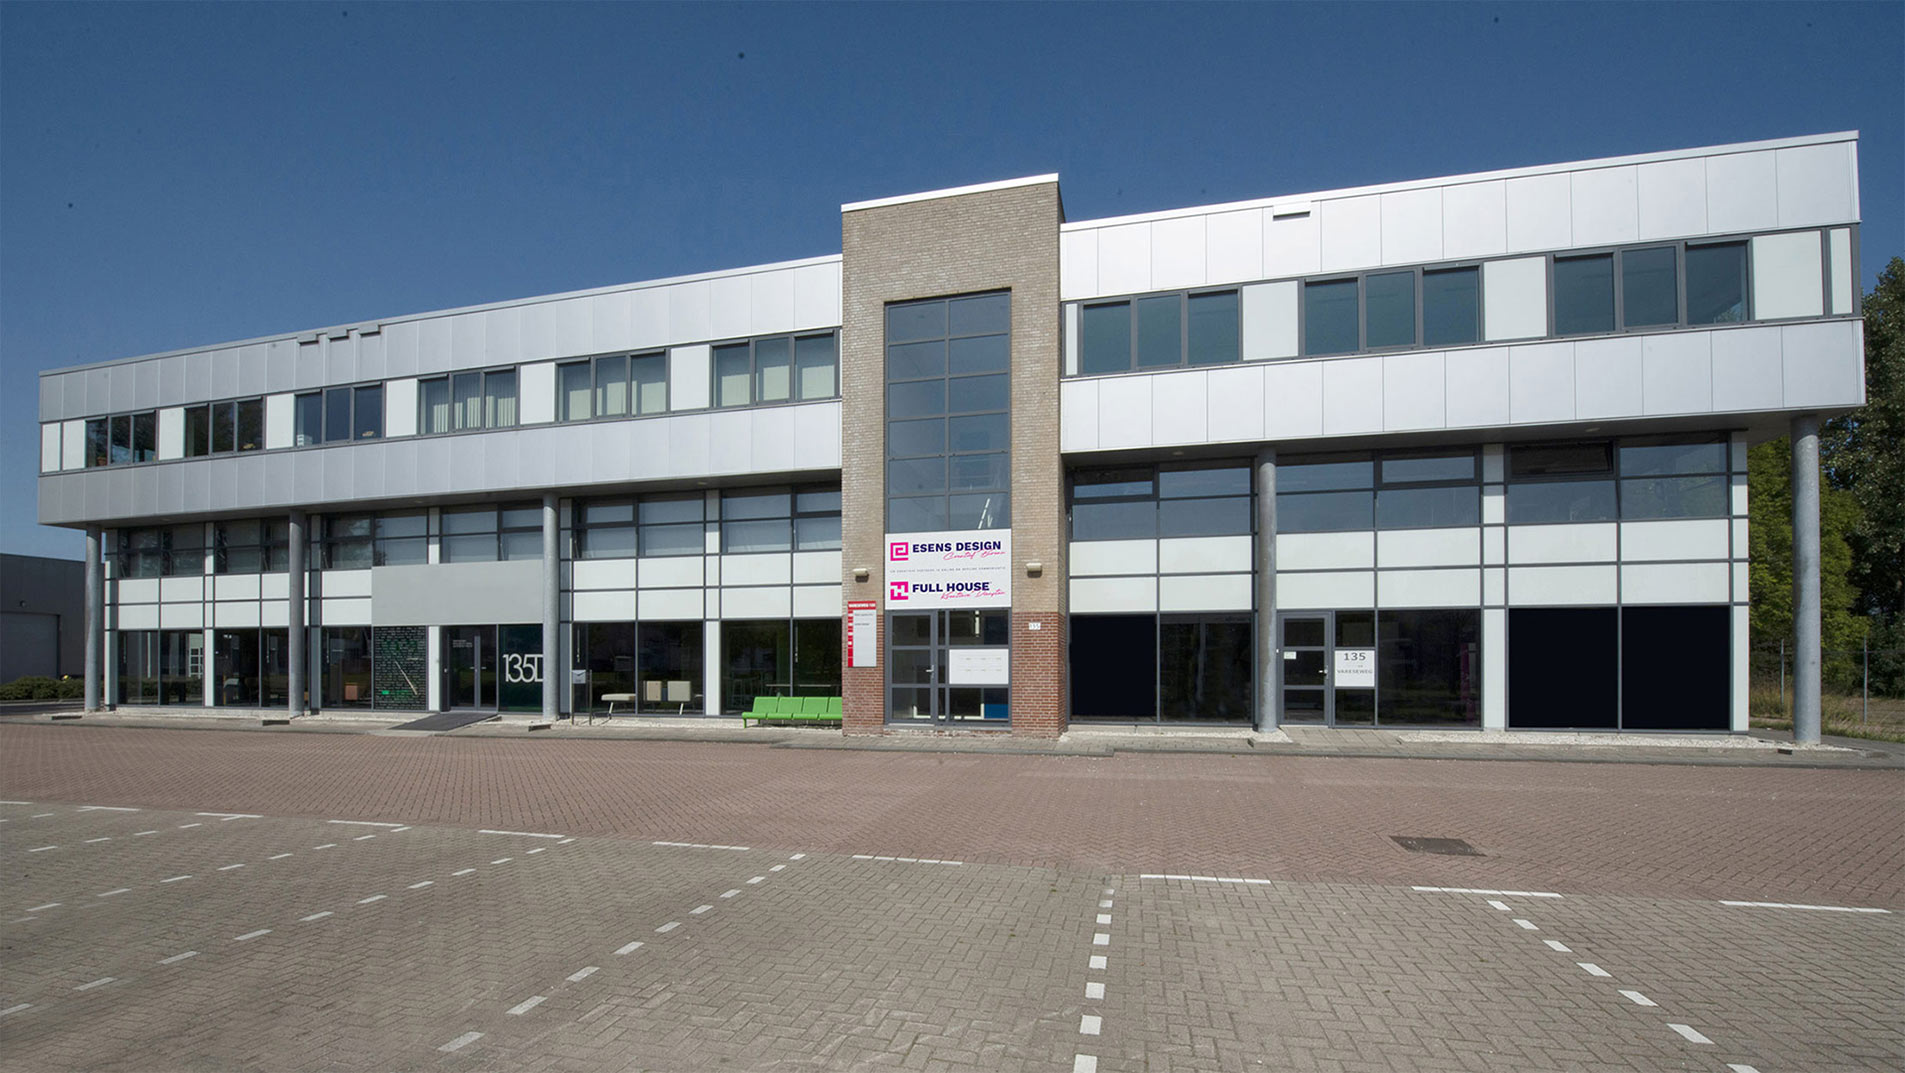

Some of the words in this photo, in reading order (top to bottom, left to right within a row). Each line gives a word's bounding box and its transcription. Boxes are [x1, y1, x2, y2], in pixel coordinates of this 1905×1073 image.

[912, 543, 952, 553] ESENS
[956, 541, 1002, 551] DESIGN
[912, 584, 943, 593] FULL
[946, 582, 990, 592] HOUSE
[1343, 652, 1366, 661] 135
